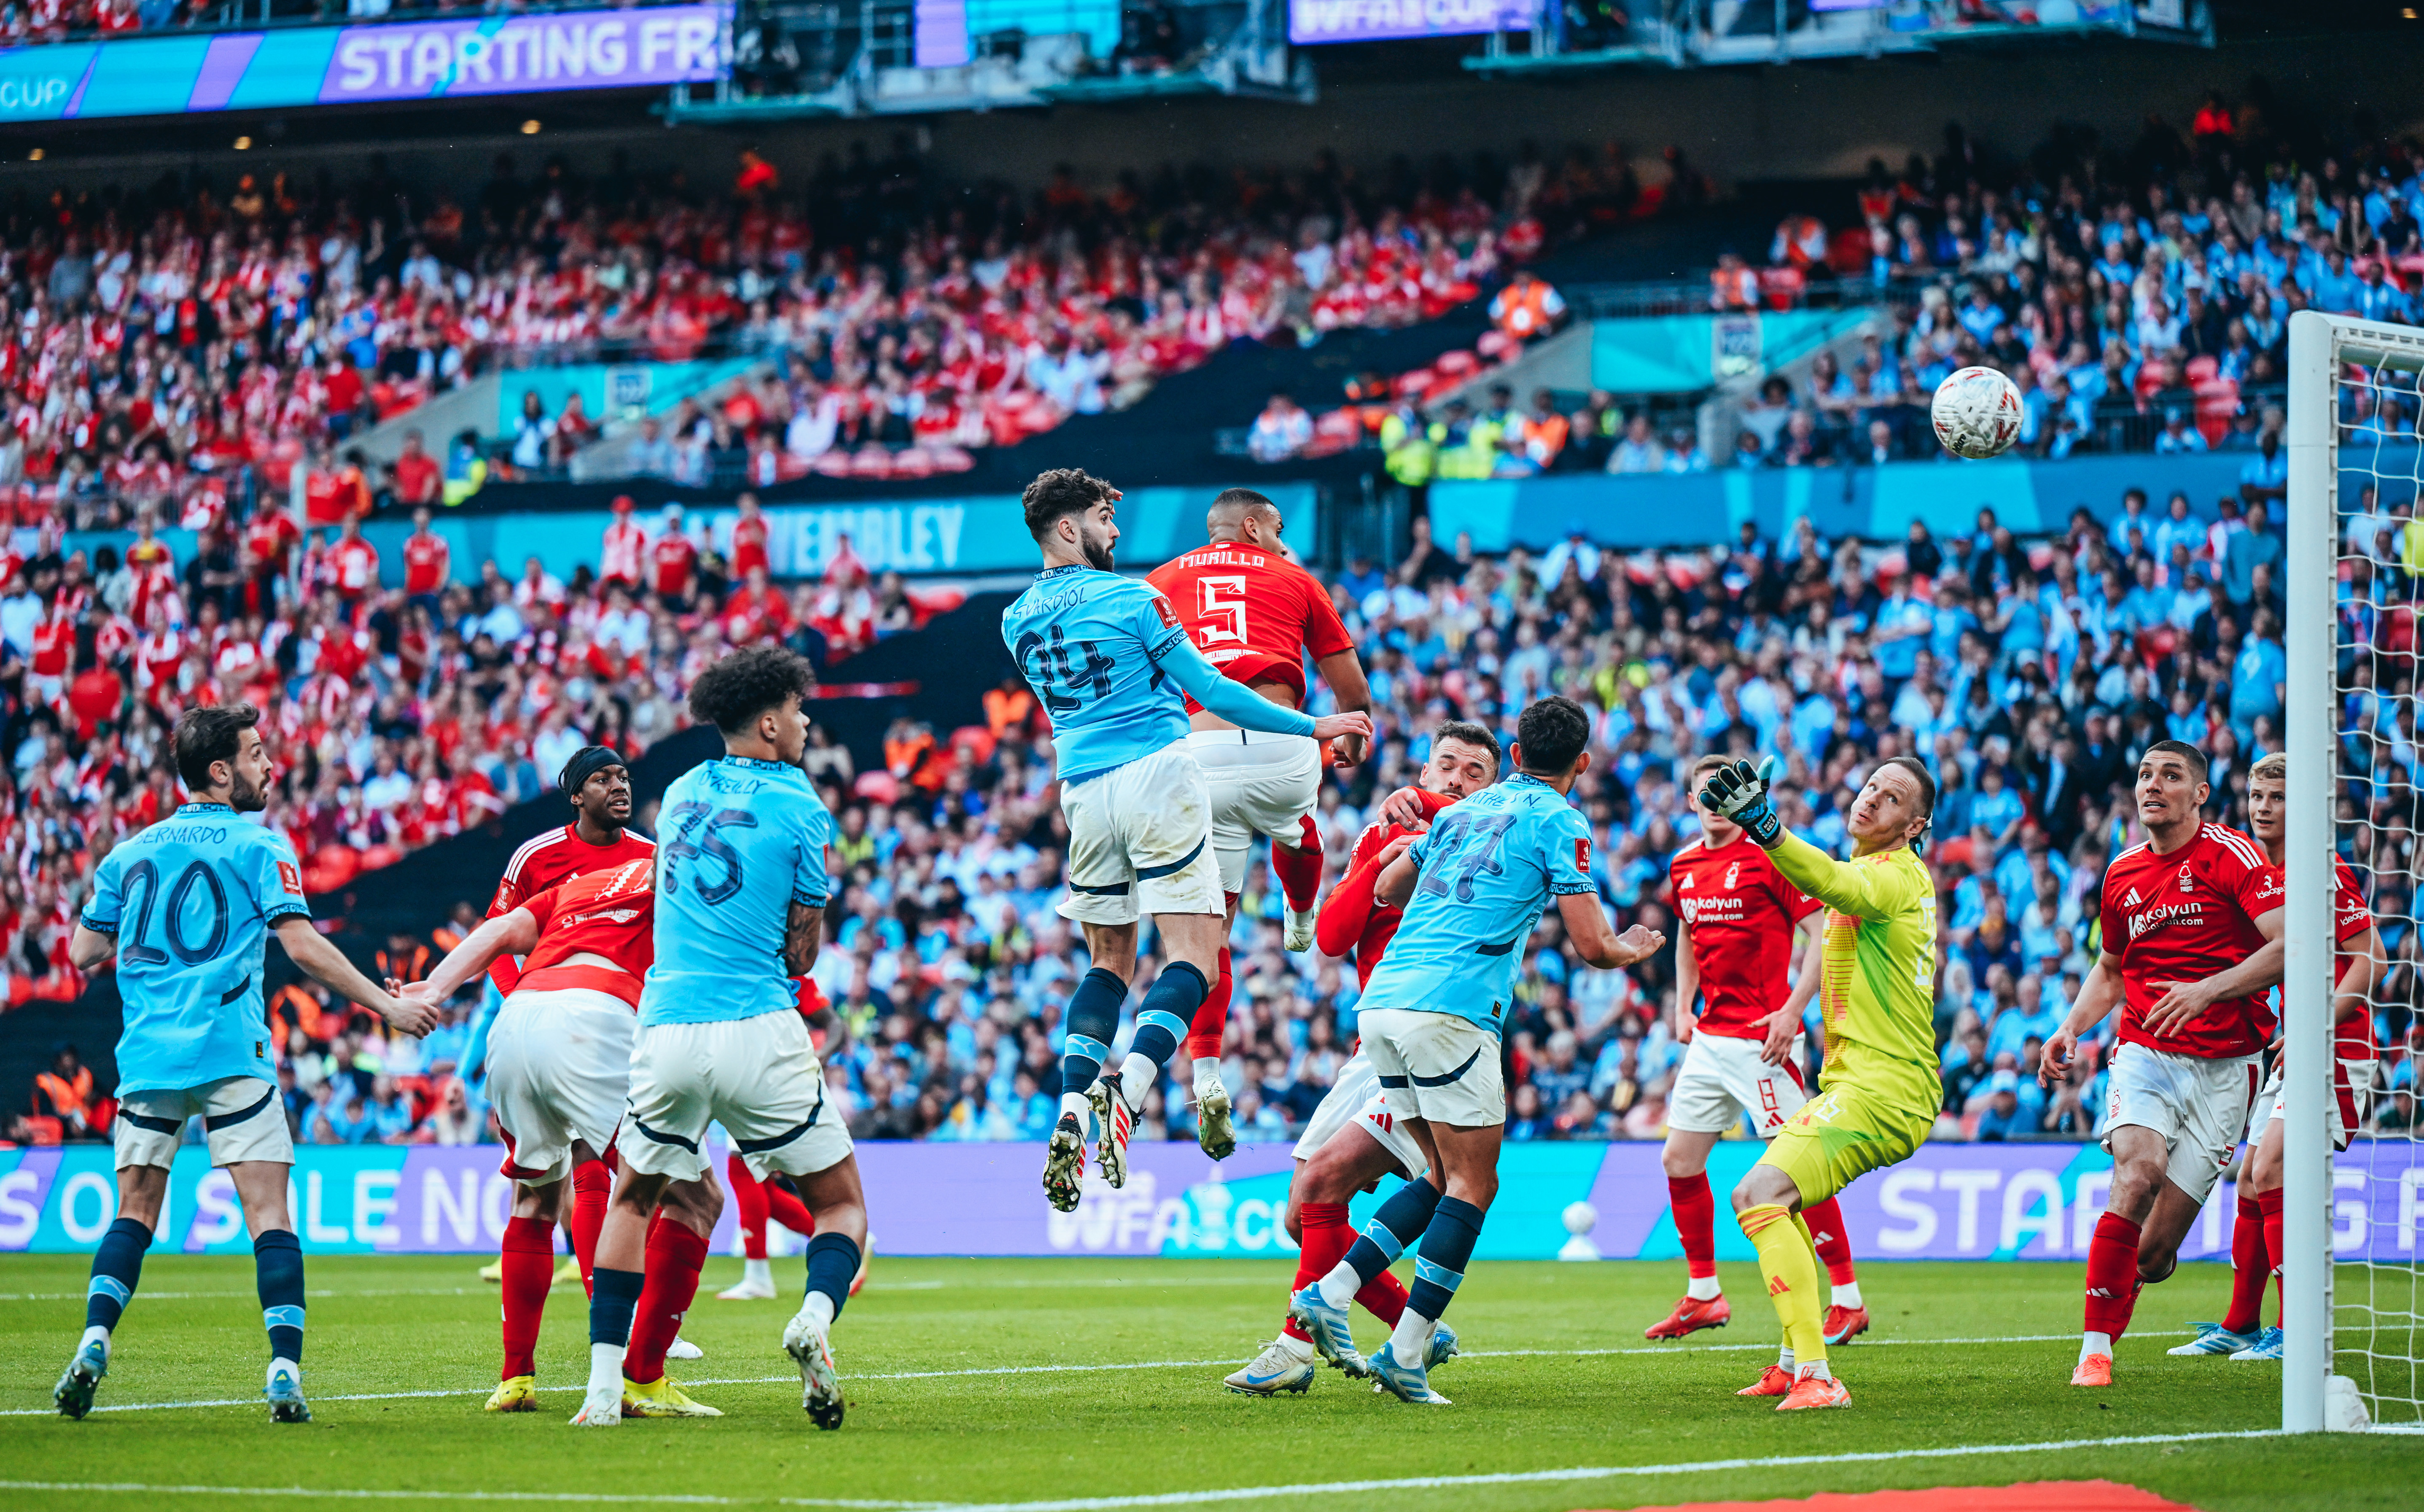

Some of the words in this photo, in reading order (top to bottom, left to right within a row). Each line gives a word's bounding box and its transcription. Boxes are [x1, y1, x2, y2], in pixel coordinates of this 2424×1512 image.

[339, 20, 627, 90] STARTING
[1, 78, 67, 108] CUP
[1179, 552, 1264, 569] MURILLO
[1013, 587, 1087, 619] GVARDIOL
[1197, 576, 1248, 648] 5
[1203, 648, 1242, 660] NOTTINGHAM
[1735, 802, 1765, 820] REAL
[134, 826, 226, 844] BERNARDO
[1418, 811, 1517, 904] 27
[121, 858, 229, 966] 20
[1697, 896, 1743, 912] kaiyun
[2146, 901, 2202, 923] kaiyun
[1697, 913, 1743, 923] kaiyun.com
